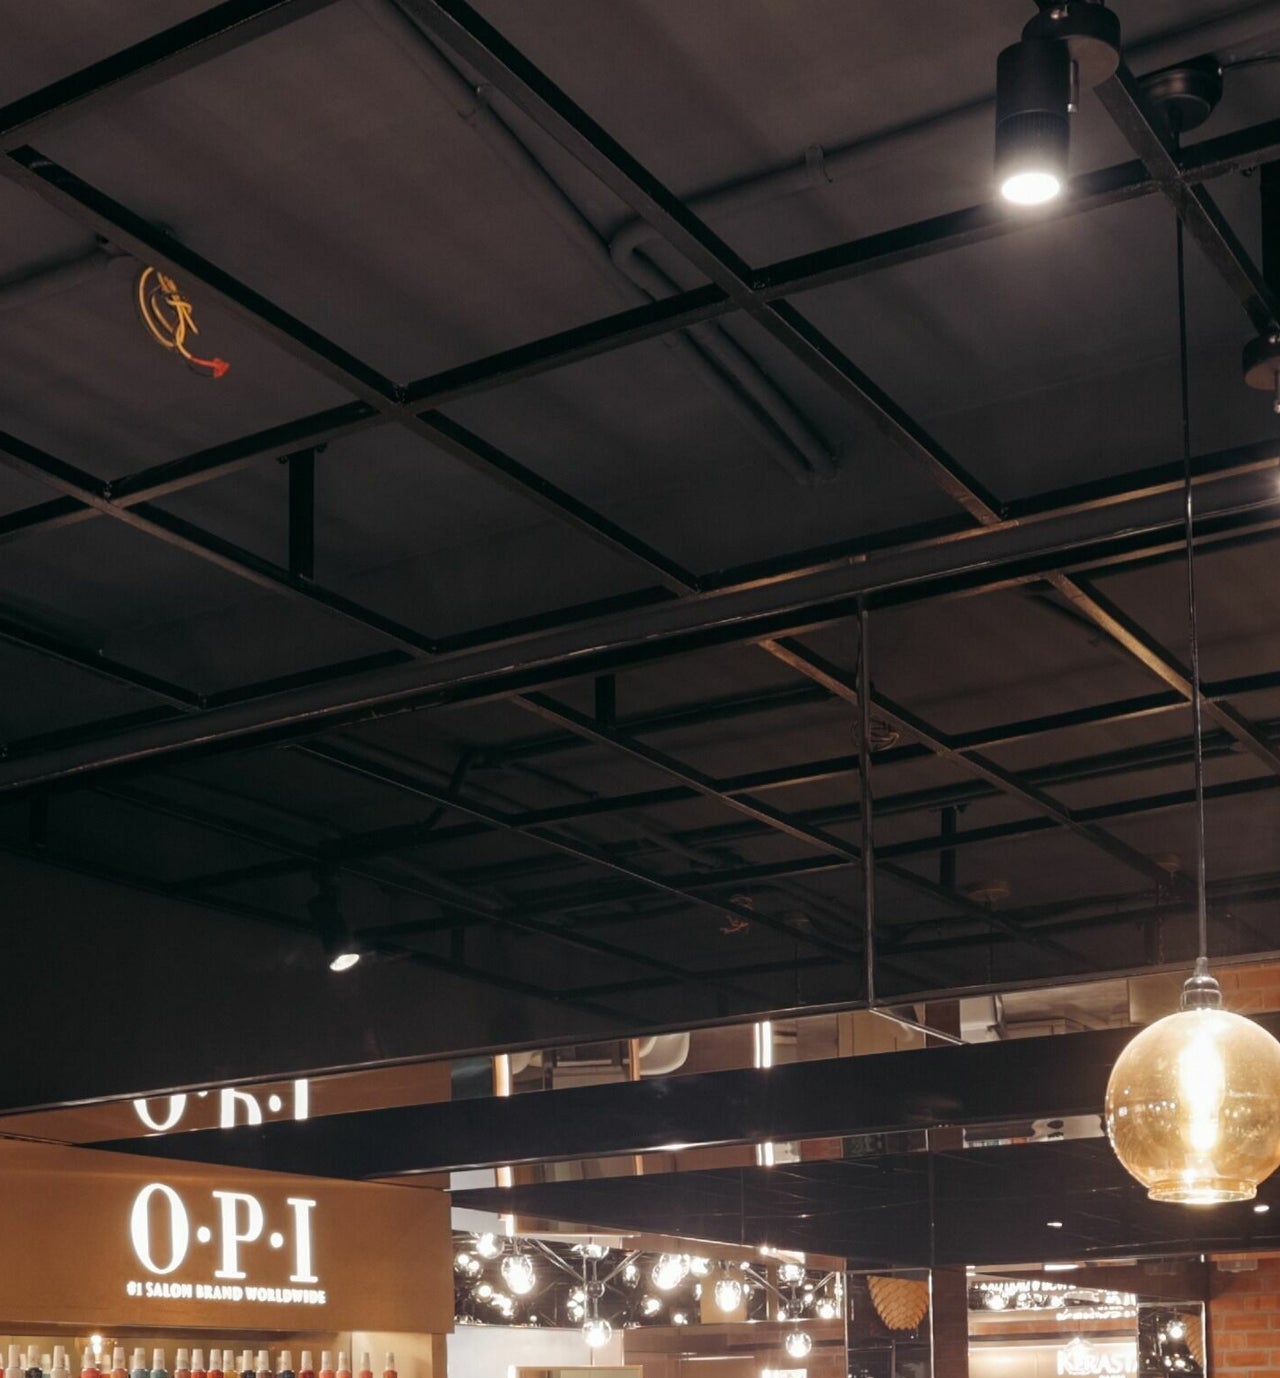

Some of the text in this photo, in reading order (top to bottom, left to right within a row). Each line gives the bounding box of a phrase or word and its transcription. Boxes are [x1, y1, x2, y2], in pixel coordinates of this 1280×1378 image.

[146, 1282, 192, 1298] SALON
[196, 1285, 243, 1301] BRAND
[245, 1287, 326, 1304] WORLDWIDE
